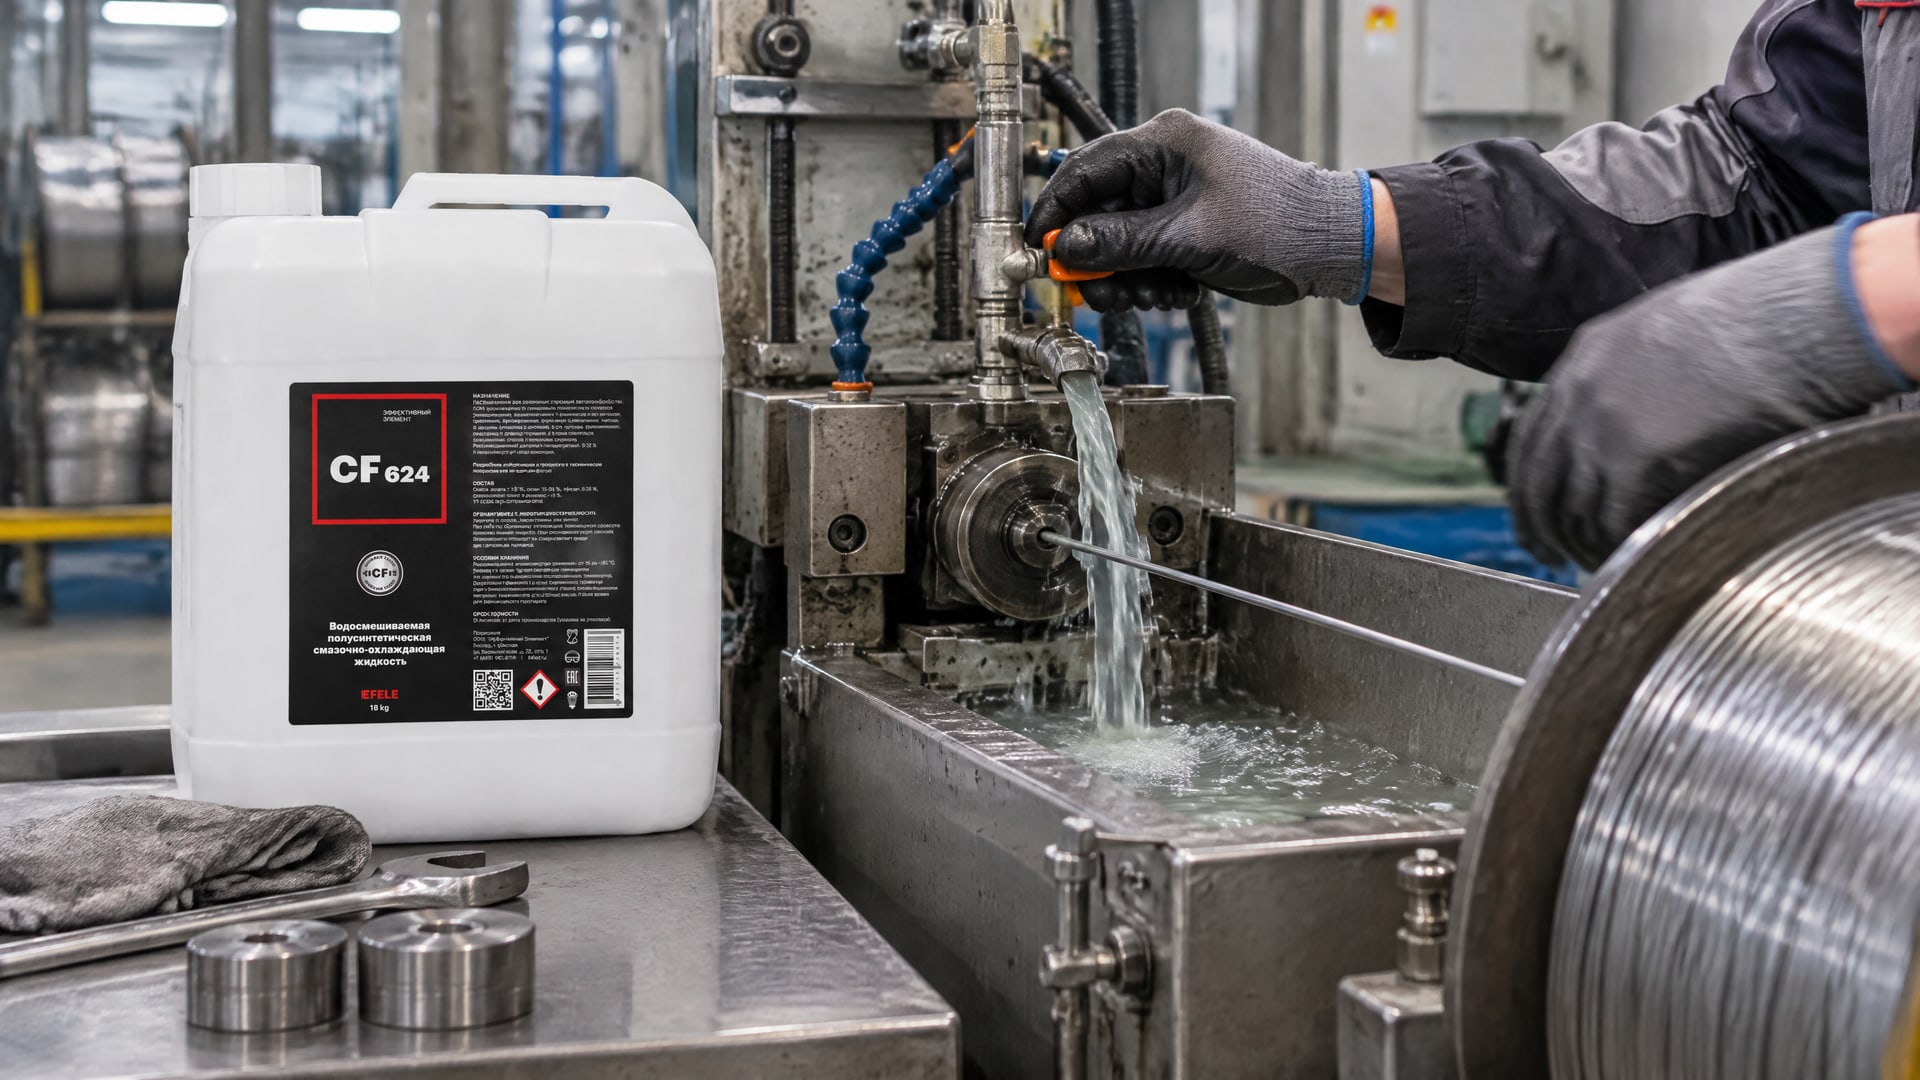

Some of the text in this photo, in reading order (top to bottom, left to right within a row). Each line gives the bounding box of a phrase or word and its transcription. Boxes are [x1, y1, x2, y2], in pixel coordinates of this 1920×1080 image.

[382, 408, 432, 416] ЭФФЕКТИВНЫЙ
[330, 454, 431, 484] CF 624
[329, 622, 431, 632] Водосмешиваемая
[327, 634, 432, 644] полусинтетическая
[313, 645, 446, 655] смазочно-охлаждающая
[354, 658, 407, 667] жидкость
[360, 689, 400, 700] EFELE
[369, 704, 390, 713] 18 kg
